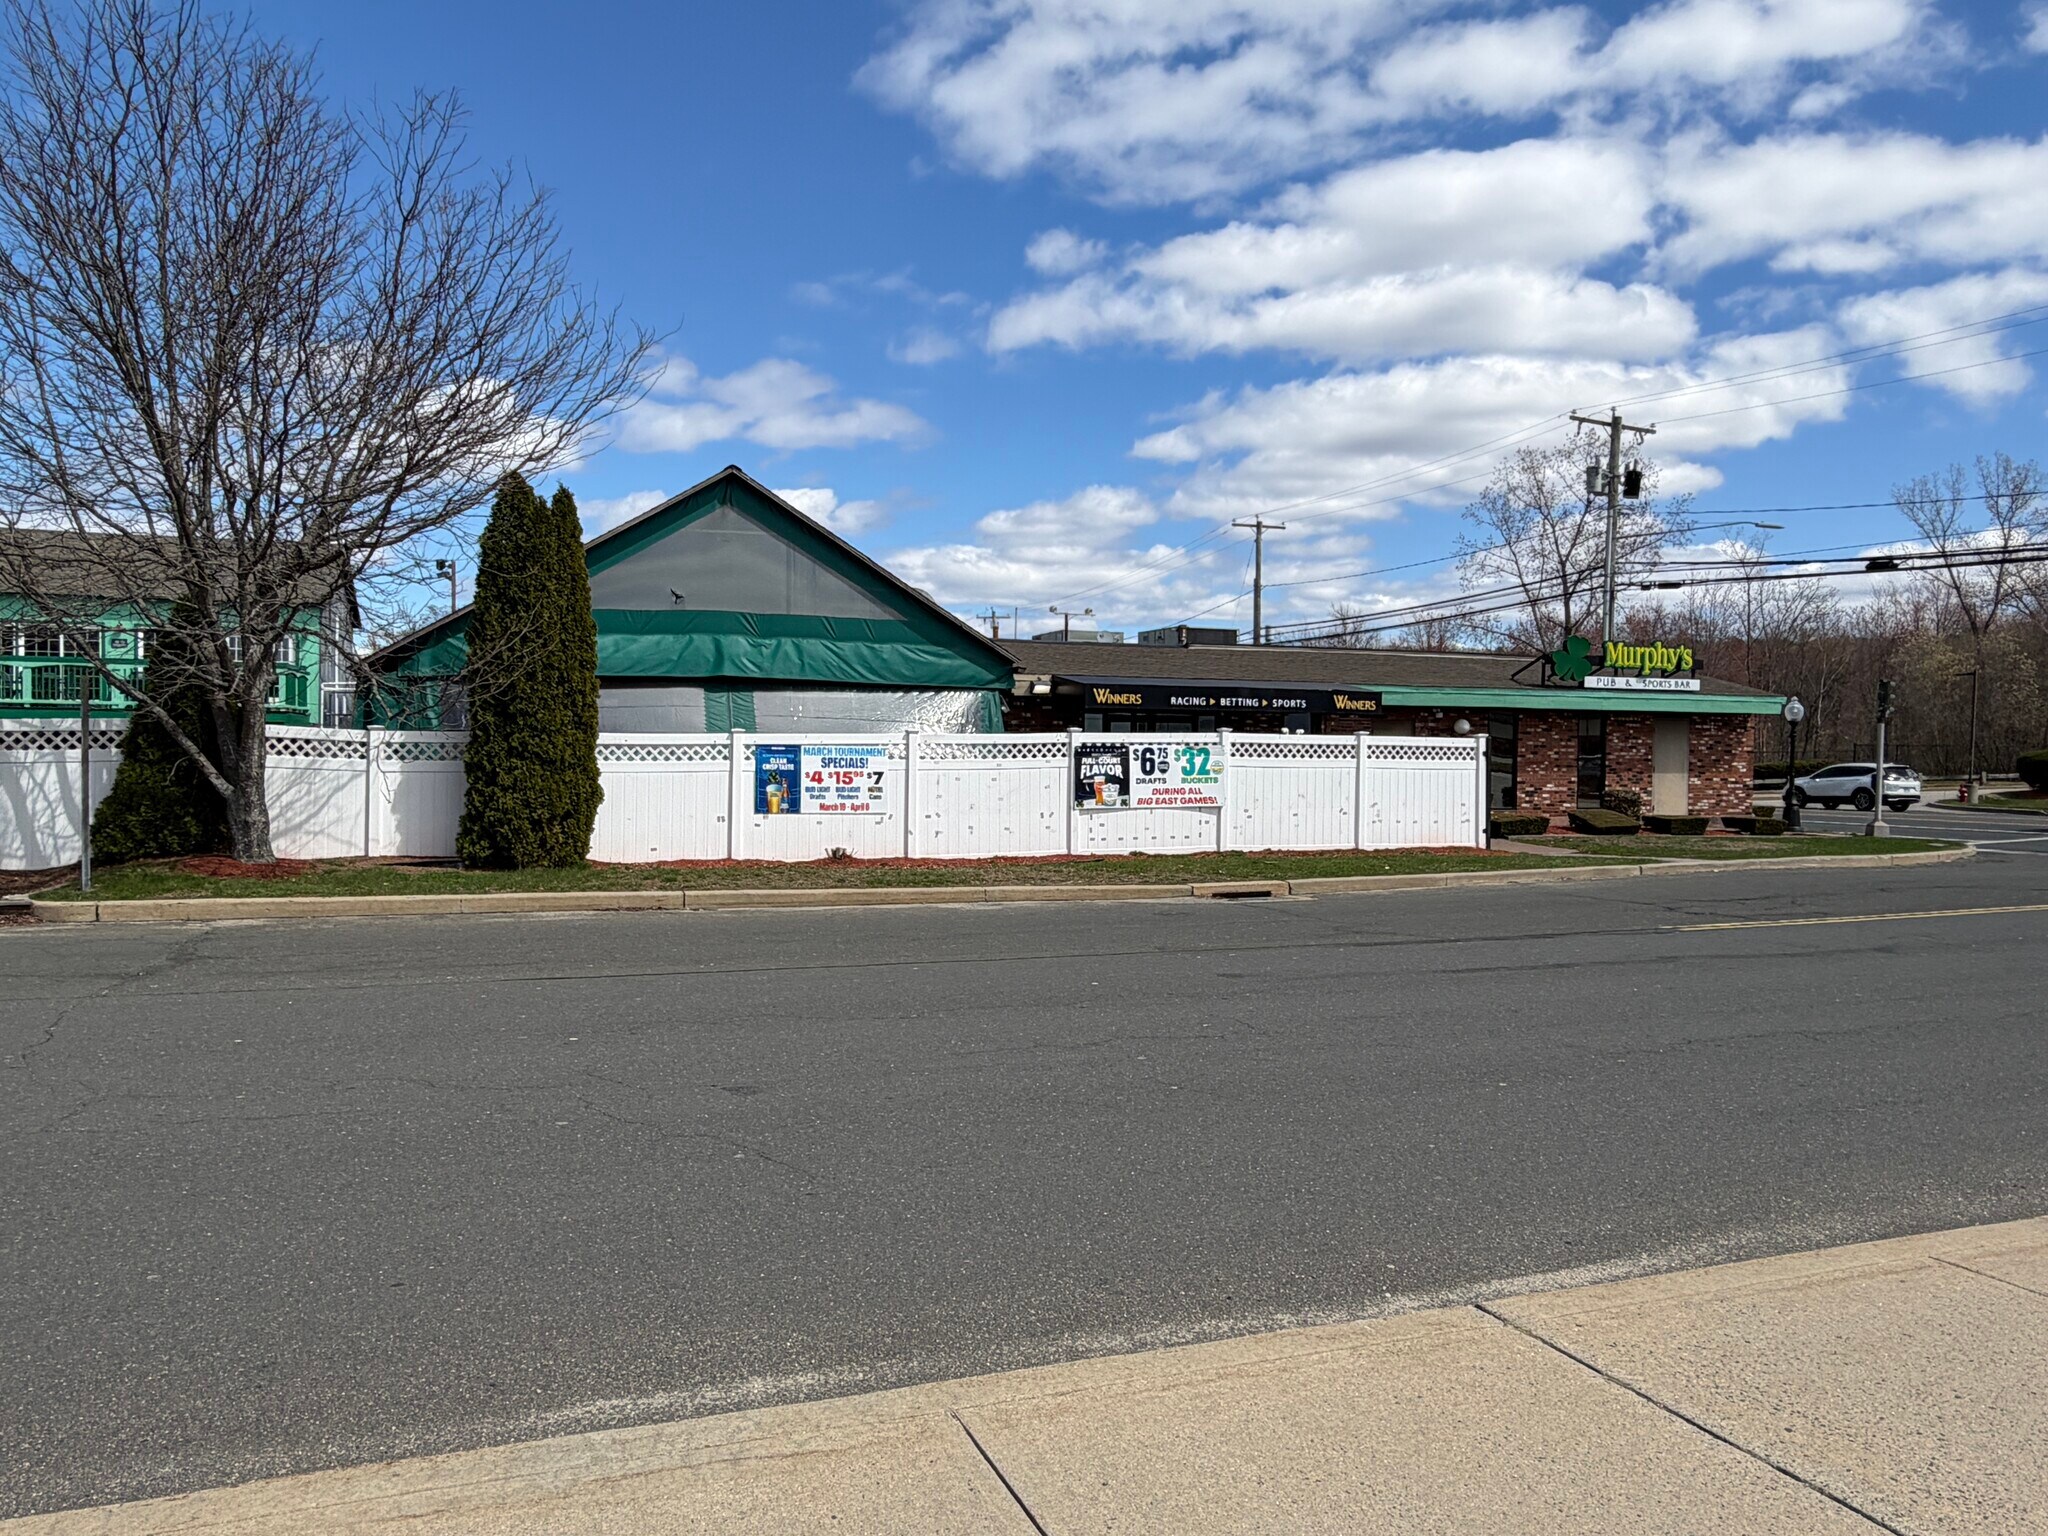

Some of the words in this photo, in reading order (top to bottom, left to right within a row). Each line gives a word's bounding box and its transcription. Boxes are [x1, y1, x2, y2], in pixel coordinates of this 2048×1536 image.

[1605, 641, 1693, 675] Murphy's
[1596, 678, 1617, 687] PUB
[1625, 679, 1632, 687] &
[1642, 679, 1672, 688] SPORTS
[1674, 680, 1691, 689] BAR
[1170, 697, 1206, 706] RACING
[1220, 698, 1259, 707] BETTING
[1272, 699, 1307, 708] SPORTS
[803, 747, 833, 757] MARCH
[834, 748, 886, 757] TOURNAMENT
[821, 757, 869, 769] SPECIALS!
[1174, 746, 1211, 776] $32
[1080, 764, 1124, 780] FLAVOR
[804, 771, 824, 785] $4
[866, 771, 885, 785] $7
[1152, 788, 1187, 796] DURING
[1188, 787, 1203, 795] ALL
[1137, 797, 1153, 805] BIG
[1155, 797, 1178, 805] EAST
[1180, 796, 1218, 805] GAMES!
[819, 803, 839, 811] March
[850, 803, 865, 812] April
